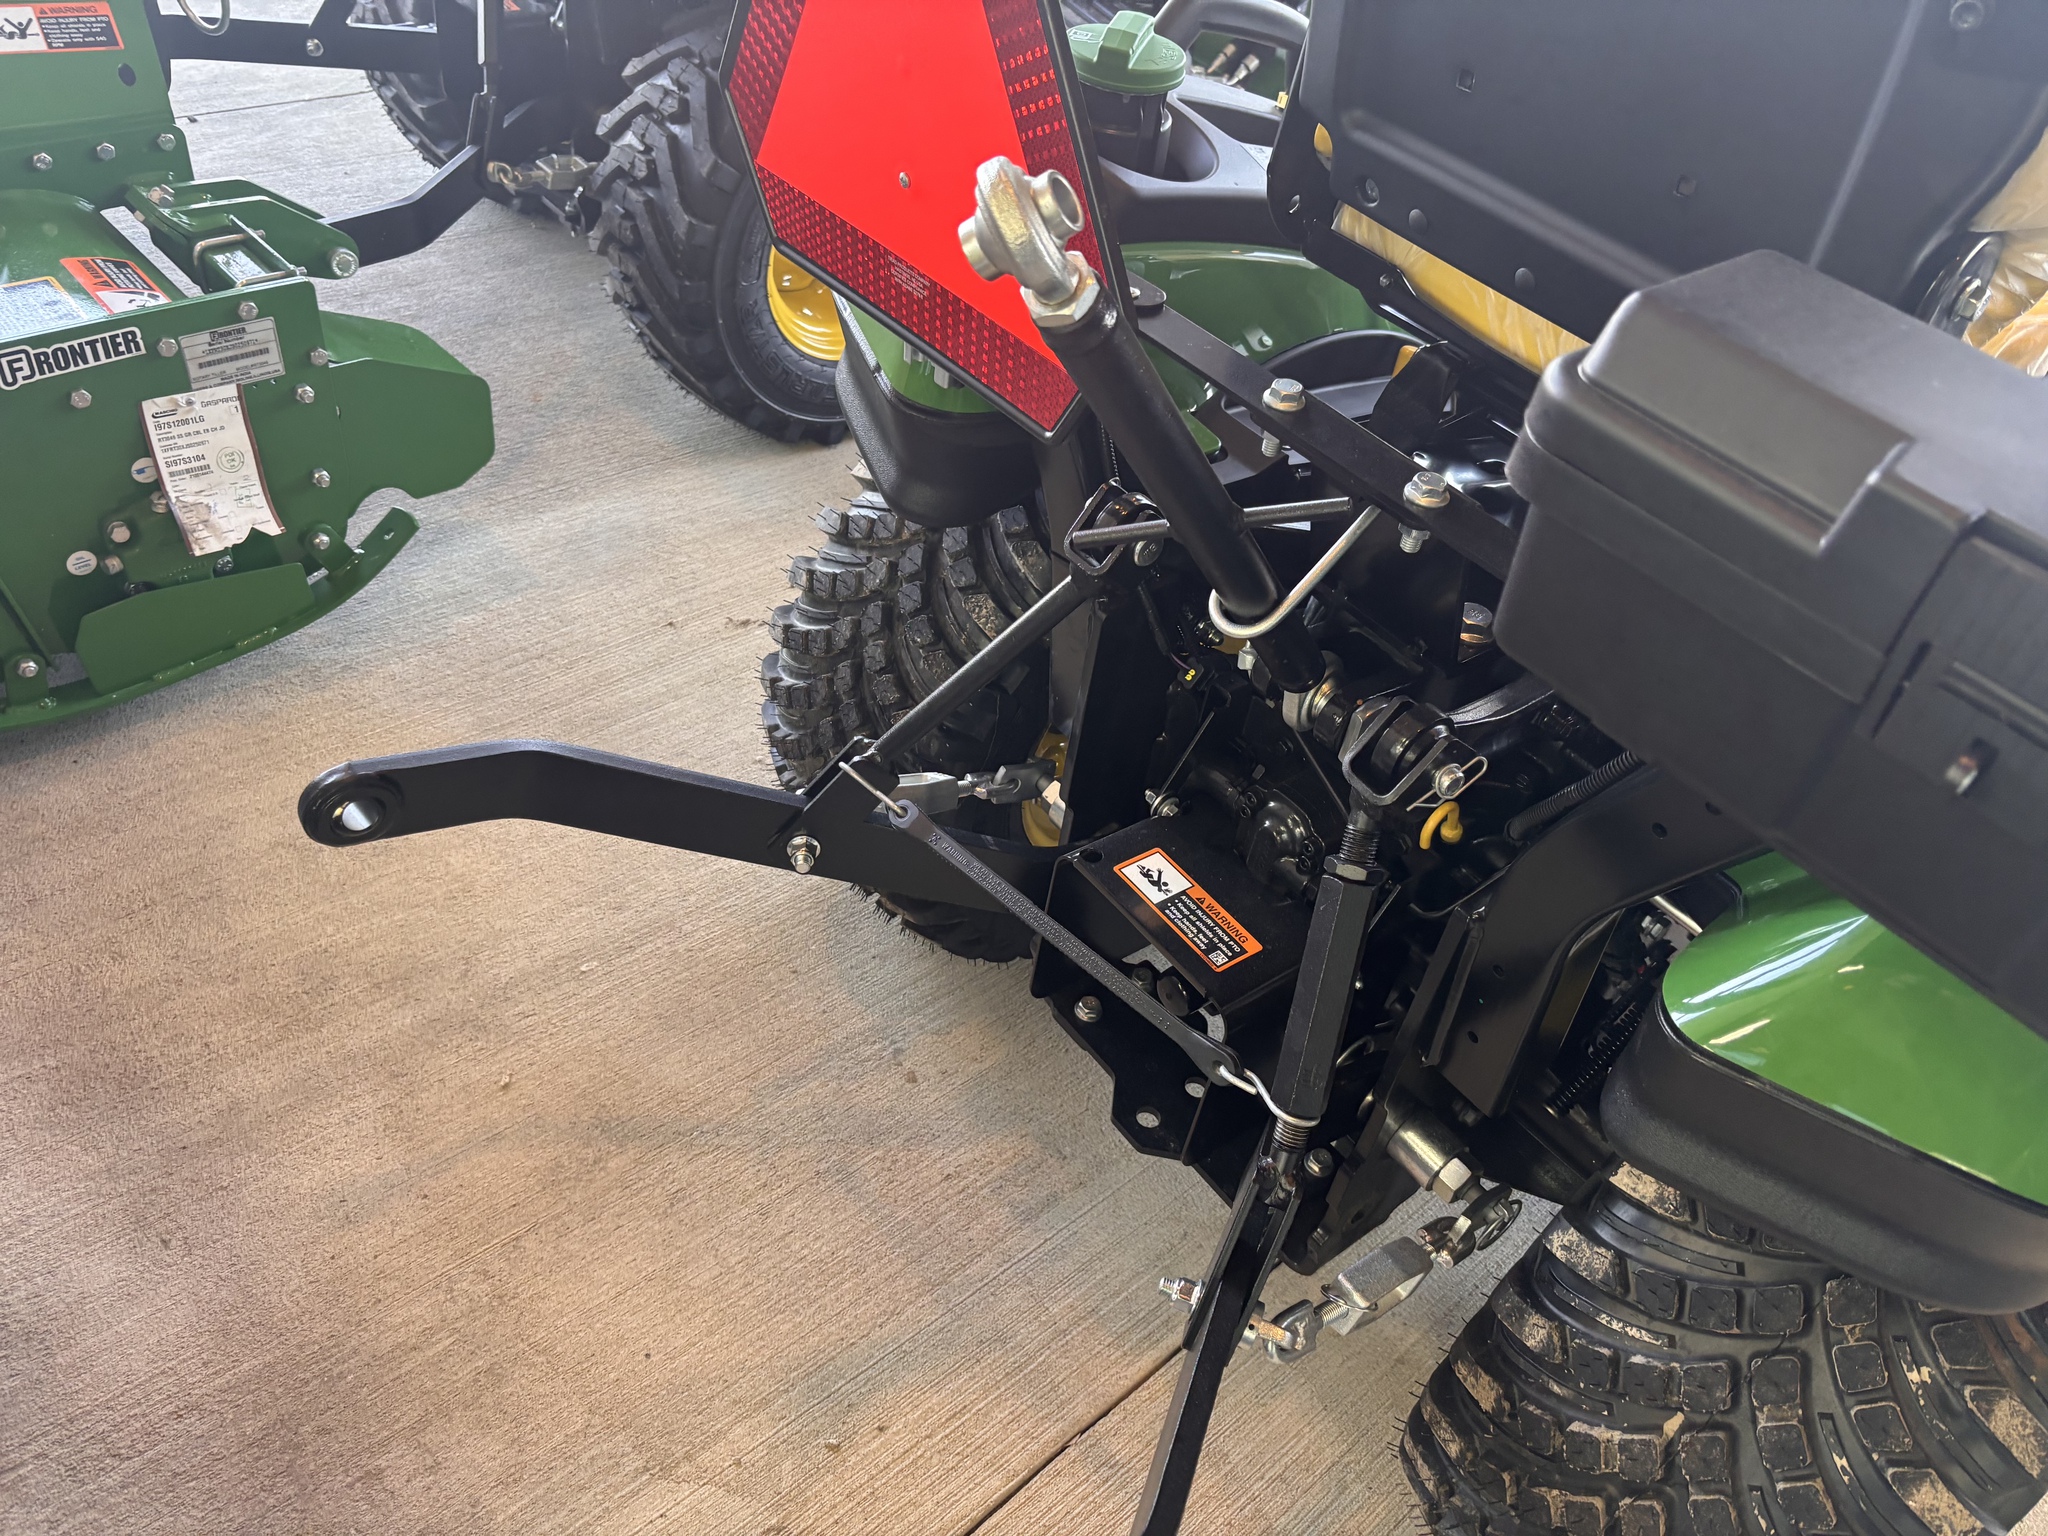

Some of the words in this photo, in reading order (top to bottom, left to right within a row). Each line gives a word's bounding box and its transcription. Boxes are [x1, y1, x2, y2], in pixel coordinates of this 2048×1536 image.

[48, 6, 98, 14] WARNING
[209, 327, 247, 342] FRONTIER
[0, 330, 143, 387] FRONTIER
[234, 405, 239, 413] 1
[164, 453, 206, 469] SI97S3104
[1164, 909, 1176, 919] and
[1173, 918, 1195, 938] clothing
[1192, 936, 1208, 950] away
[1169, 906, 1183, 919] Keep
[1197, 933, 1209, 944] feet
[1177, 902, 1190, 915] Keep
[1188, 914, 1198, 922] all
[1195, 921, 1214, 938] shields
[1212, 936, 1220, 944] in
[1216, 942, 1233, 957] place
[1180, 895, 1197, 910] AVOID
[1195, 909, 1215, 927] INJURY
[1213, 926, 1231, 942] FROM
[1228, 941, 1241, 953] PTO
[1205, 903, 1249, 944] WARNING
